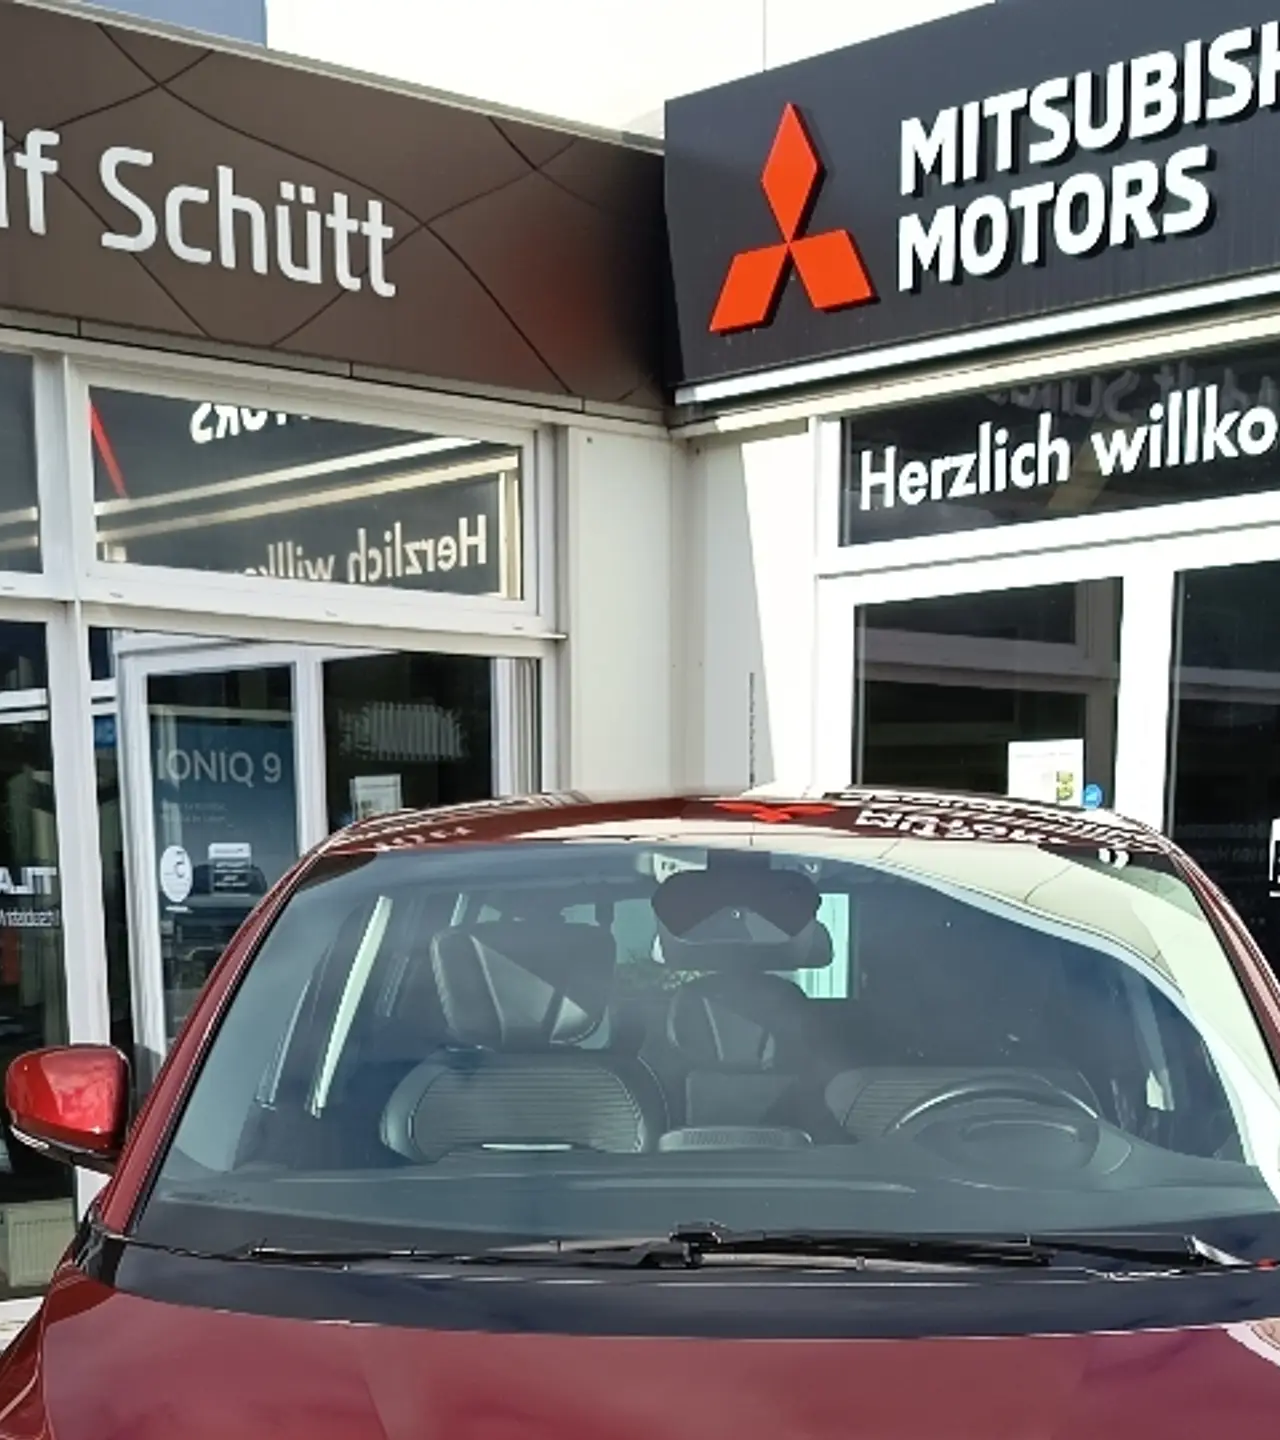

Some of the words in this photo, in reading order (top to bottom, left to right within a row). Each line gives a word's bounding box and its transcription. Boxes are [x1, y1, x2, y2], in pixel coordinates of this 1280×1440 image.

[99, 146, 396, 298] Schütt
[897, 144, 1214, 292] MOTORS
[860, 412, 1071, 511] Herzlich
[157, 749, 255, 788] IONIQ
[262, 751, 282, 784] 9
